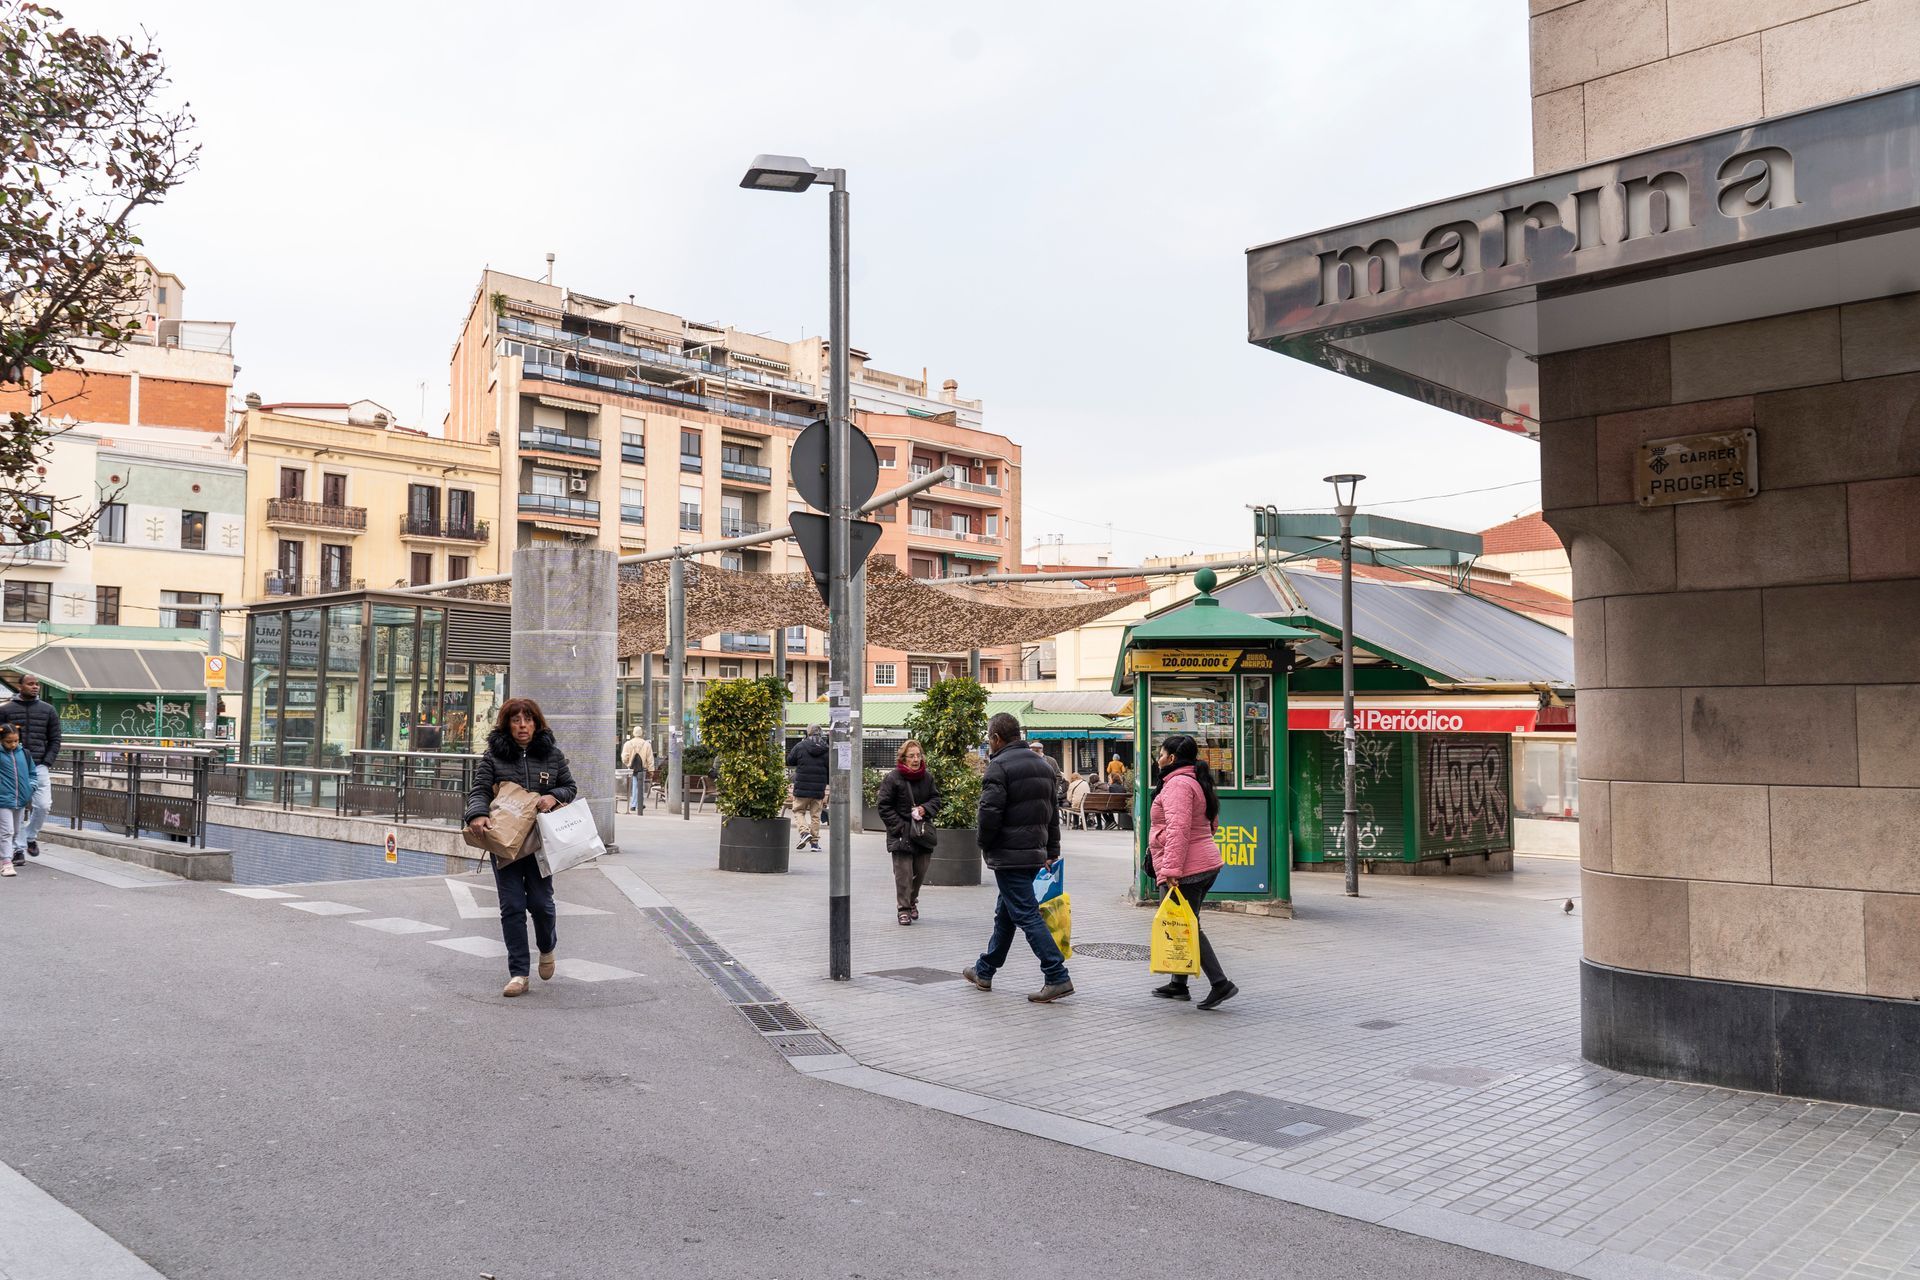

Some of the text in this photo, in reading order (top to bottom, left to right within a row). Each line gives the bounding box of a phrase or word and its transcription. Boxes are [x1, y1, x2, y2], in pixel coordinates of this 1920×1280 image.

[1317, 146, 1803, 306] marina
[1679, 447, 1736, 464] CARRER
[1162, 657, 1229, 667] 120.000.000 €
[1367, 709, 1464, 731] Periódico
[555, 819, 583, 833] FLORENCIA
[1214, 825, 1257, 843] BEN
[1216, 843, 1257, 866] UGAT
